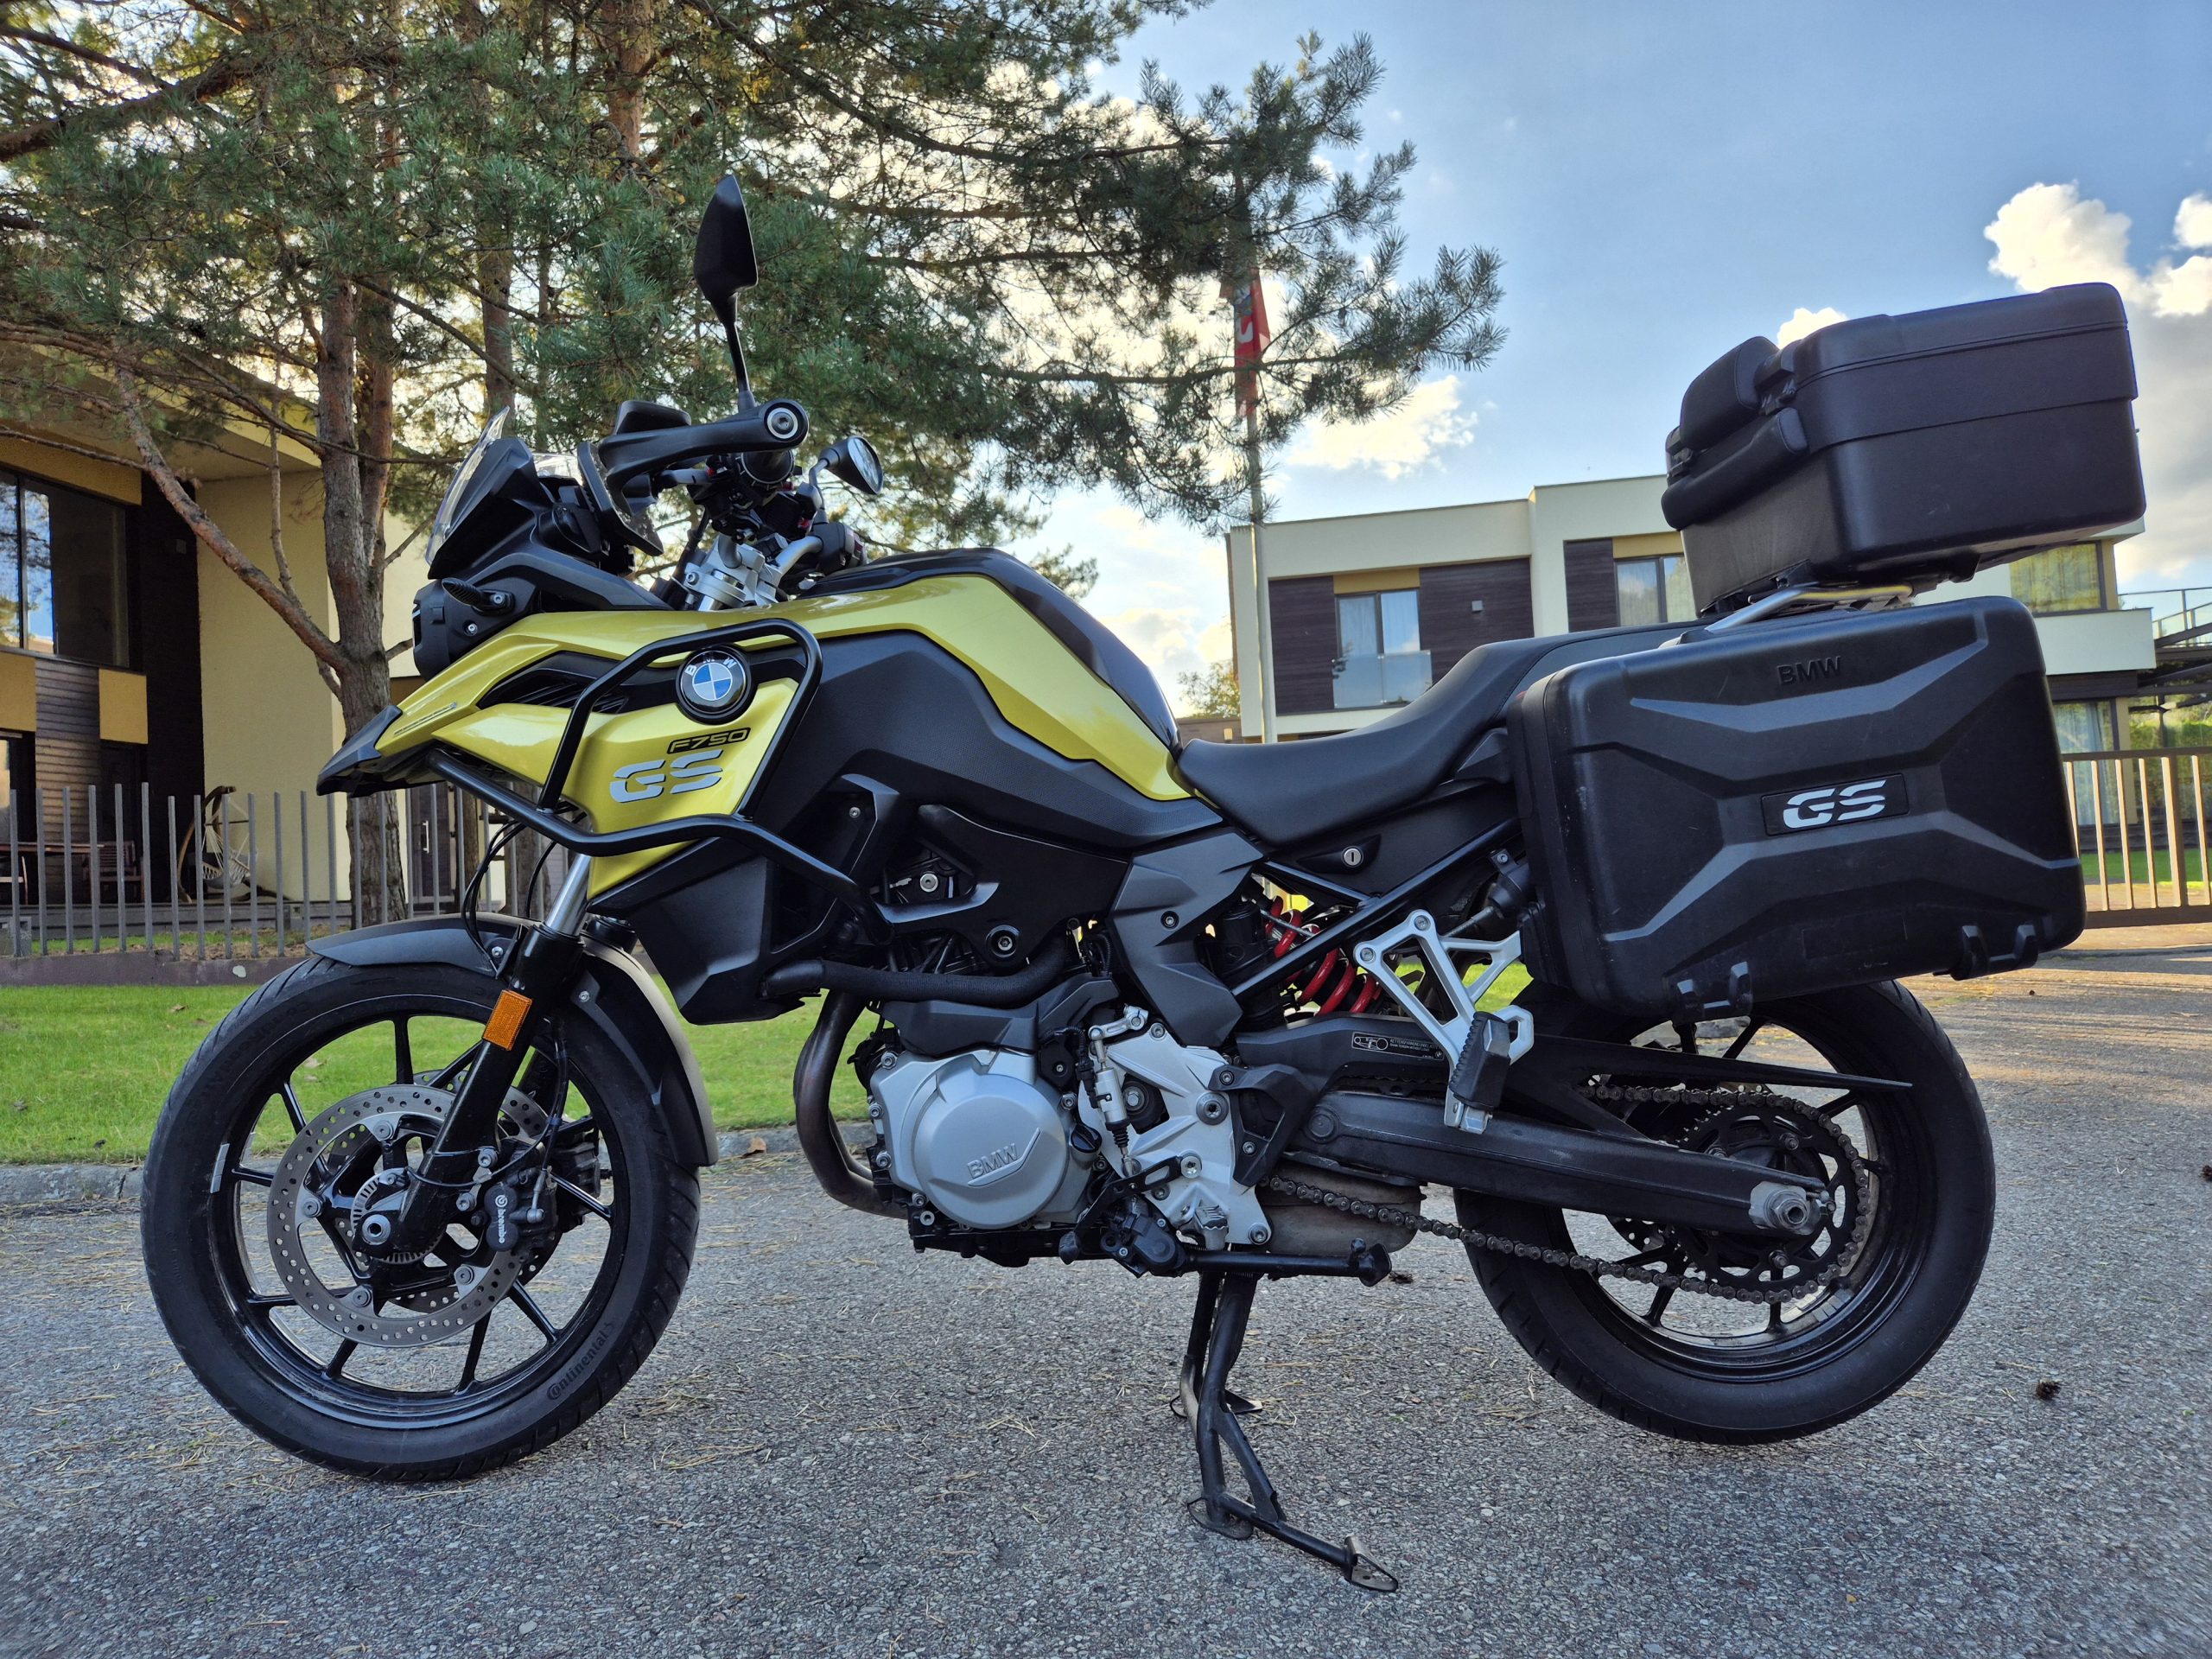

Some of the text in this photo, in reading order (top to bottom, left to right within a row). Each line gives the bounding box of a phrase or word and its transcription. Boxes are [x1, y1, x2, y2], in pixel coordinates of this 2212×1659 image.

[1777, 655, 1841, 685] BMW
[671, 729, 749, 753] F750
[609, 749, 723, 803] GS
[1783, 779, 1887, 829] GS
[967, 1142, 1018, 1179] BMW
[498, 1208, 507, 1244] brembo
[546, 1331, 609, 1401] Continental
